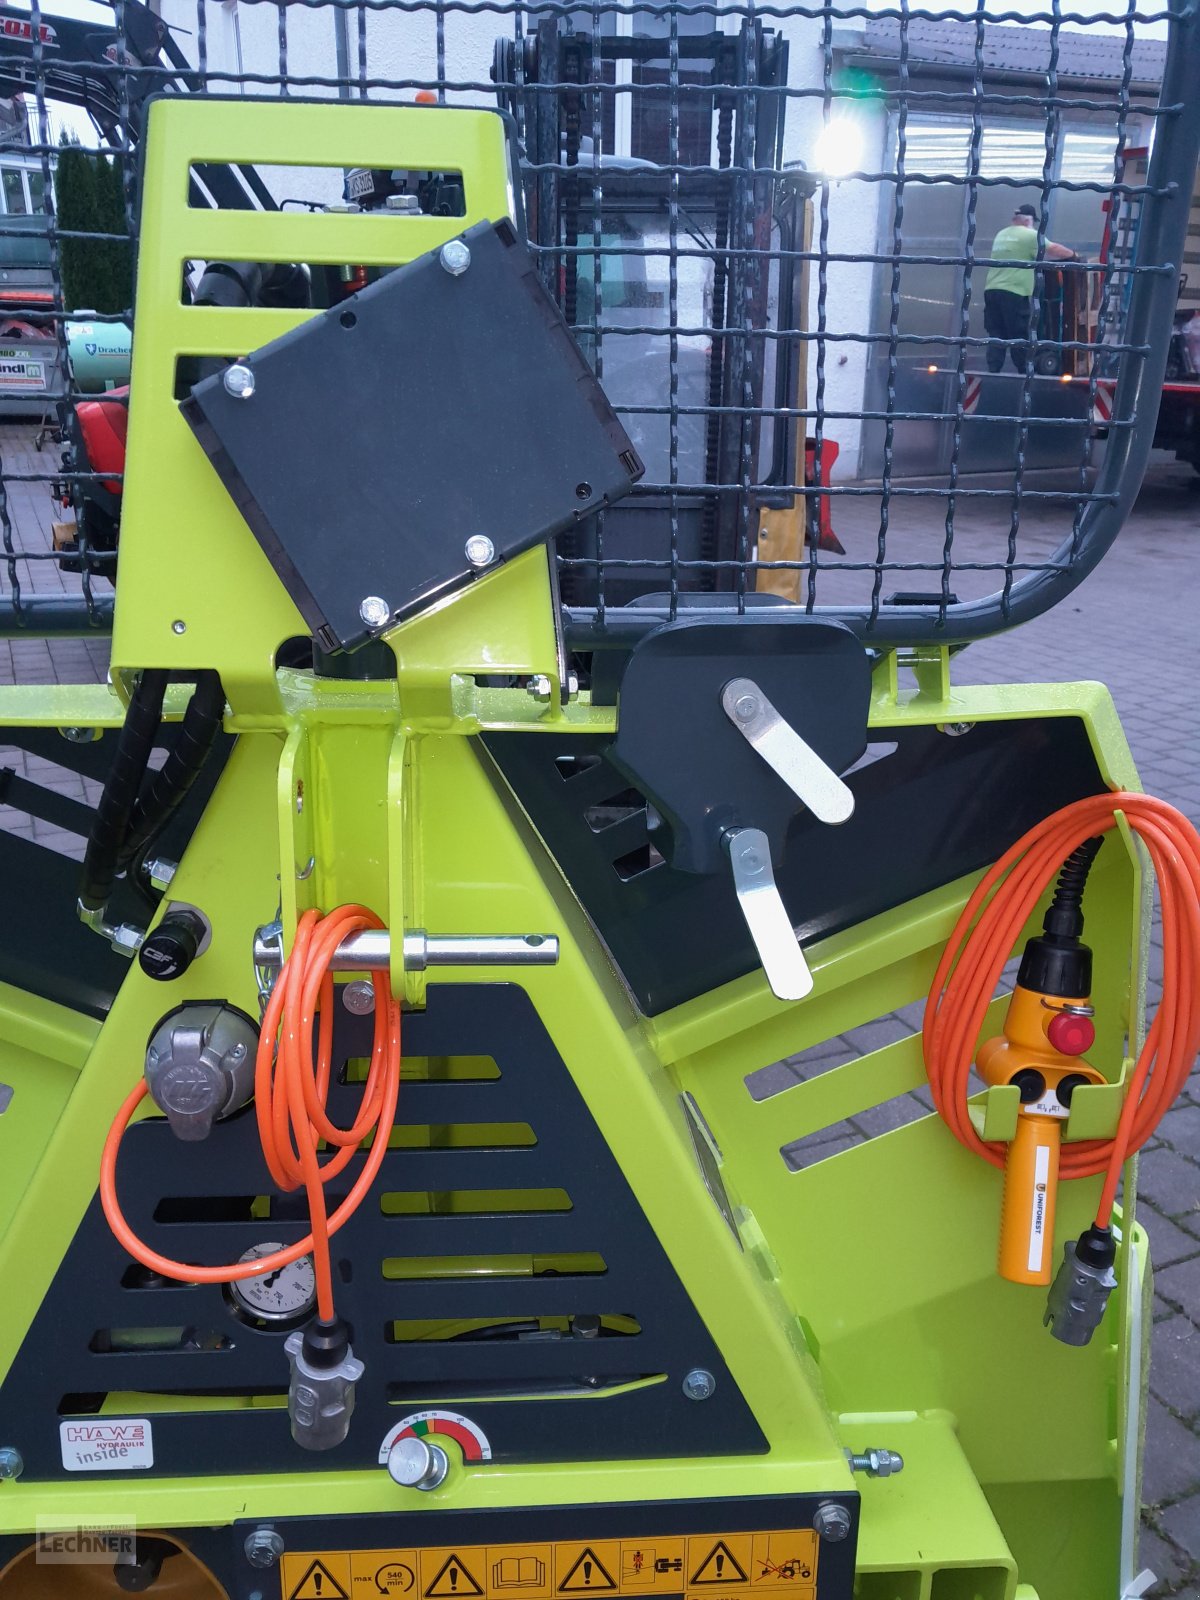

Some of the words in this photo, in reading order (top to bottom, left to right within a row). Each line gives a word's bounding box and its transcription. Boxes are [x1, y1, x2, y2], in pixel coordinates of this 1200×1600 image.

[1035, 1193, 1044, 1234] UNIFOREST
[67, 1426, 144, 1442] HAWE
[76, 1447, 129, 1465] inside
